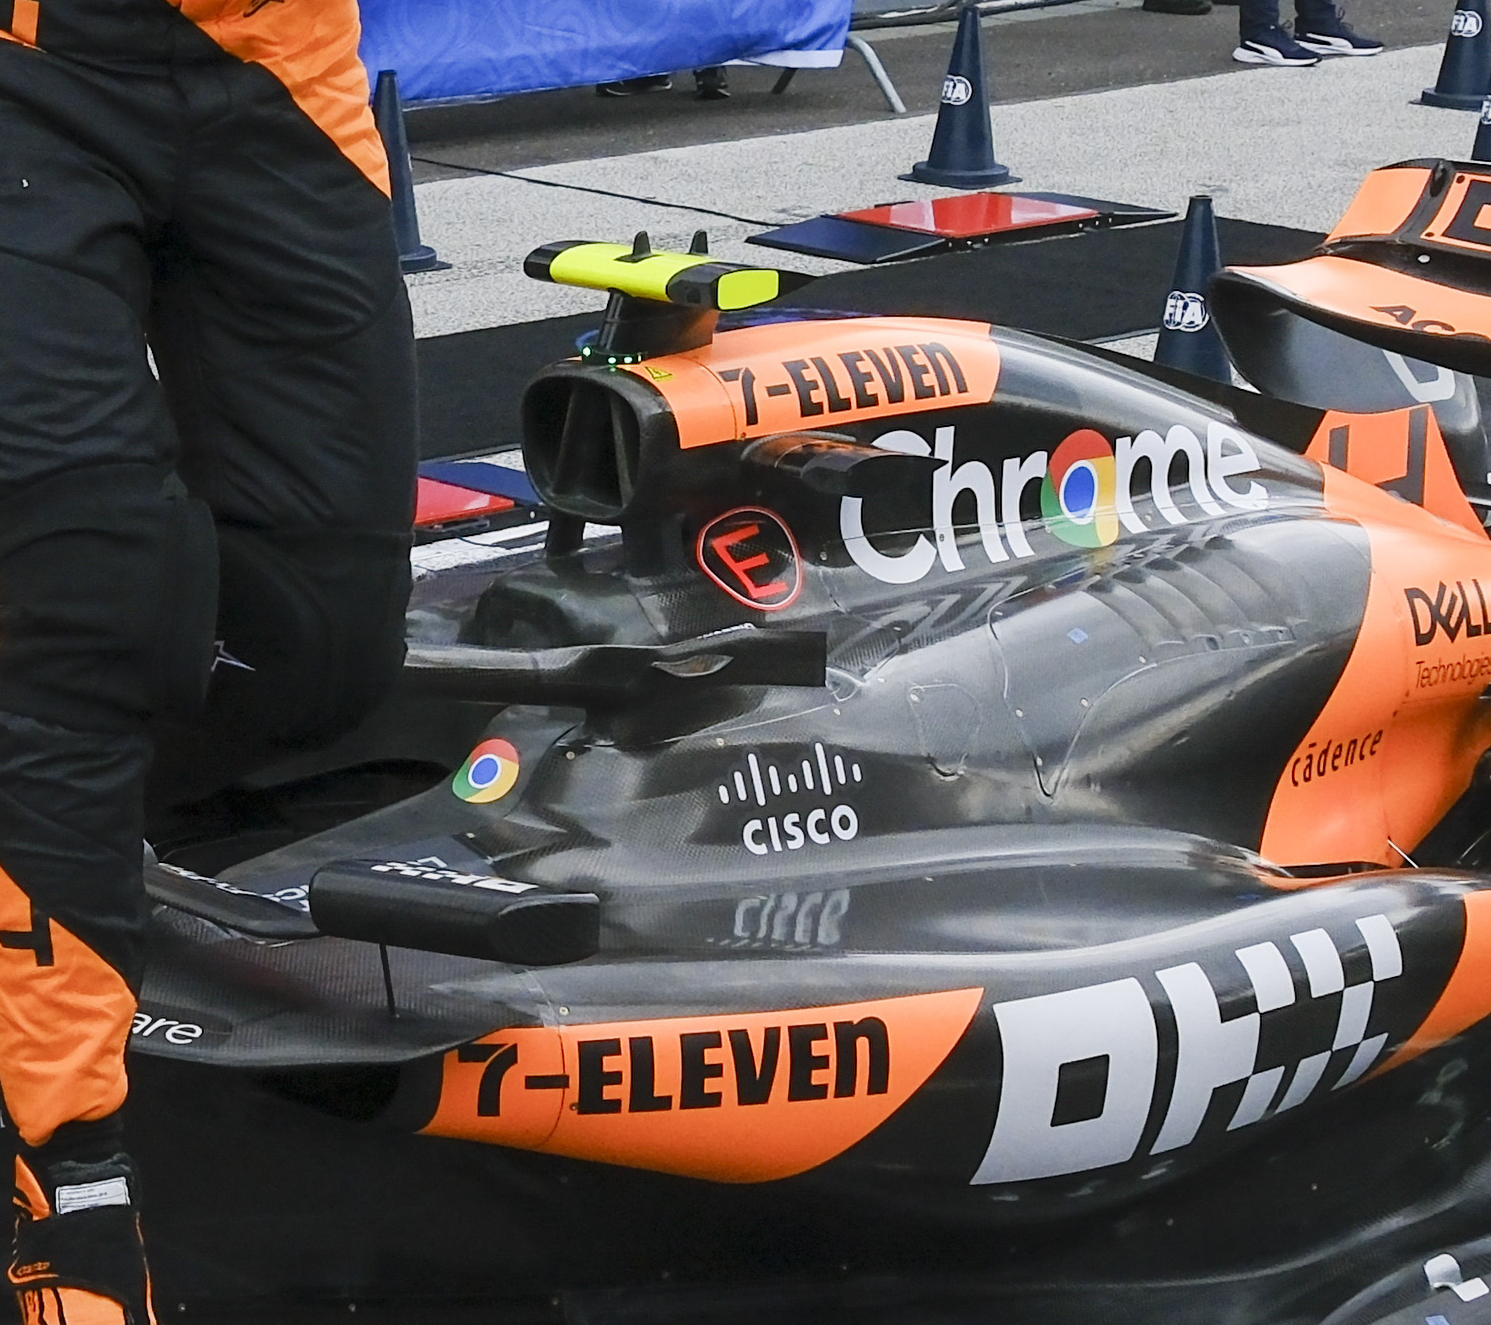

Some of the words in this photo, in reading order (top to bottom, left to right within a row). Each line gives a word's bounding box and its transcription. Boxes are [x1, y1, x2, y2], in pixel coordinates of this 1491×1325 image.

[1165, 297, 1204, 328] FIA
[709, 525, 789, 598] E
[840, 418, 1269, 585] Chrome
[971, 912, 1404, 1187] OKX
